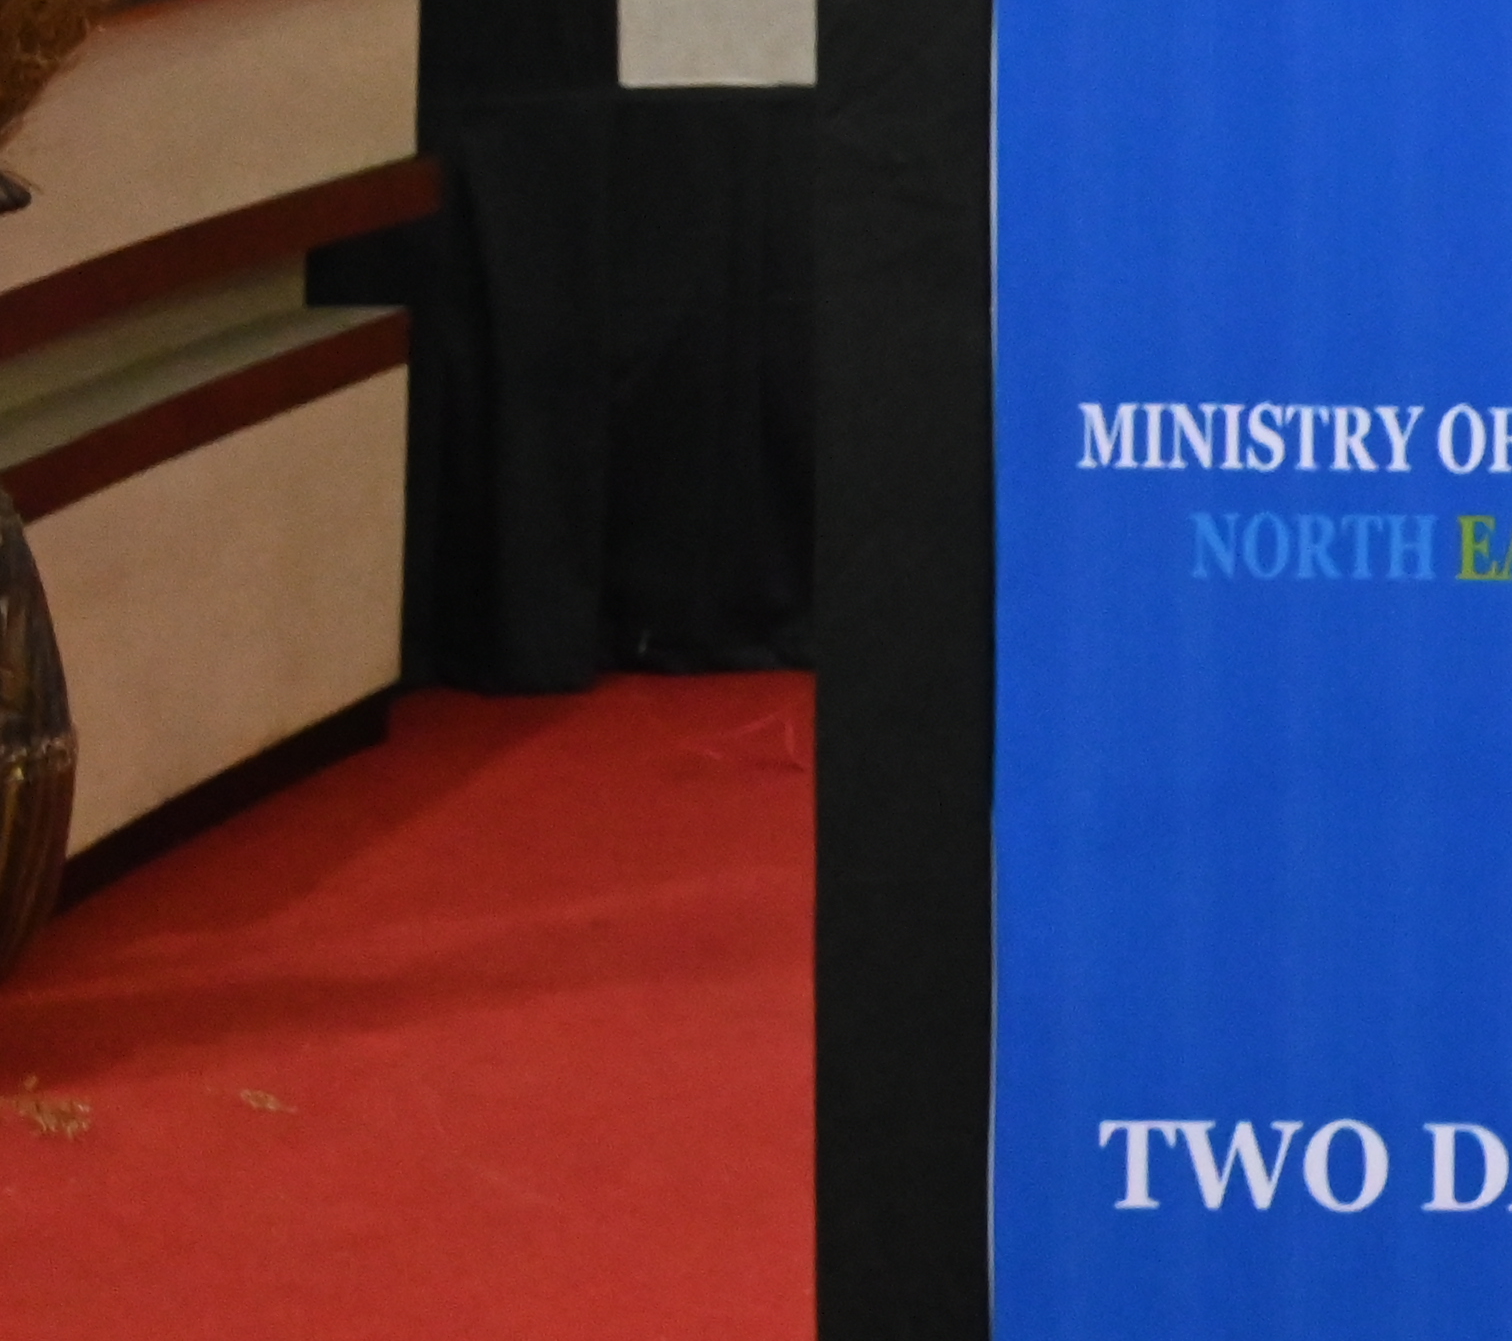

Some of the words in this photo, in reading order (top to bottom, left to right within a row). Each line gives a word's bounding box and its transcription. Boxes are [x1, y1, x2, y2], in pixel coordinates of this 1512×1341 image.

[1079, 401, 1425, 472] MINISTRY
[1190, 512, 1437, 581] NORTH
[1098, 1118, 1390, 1213] TWO
